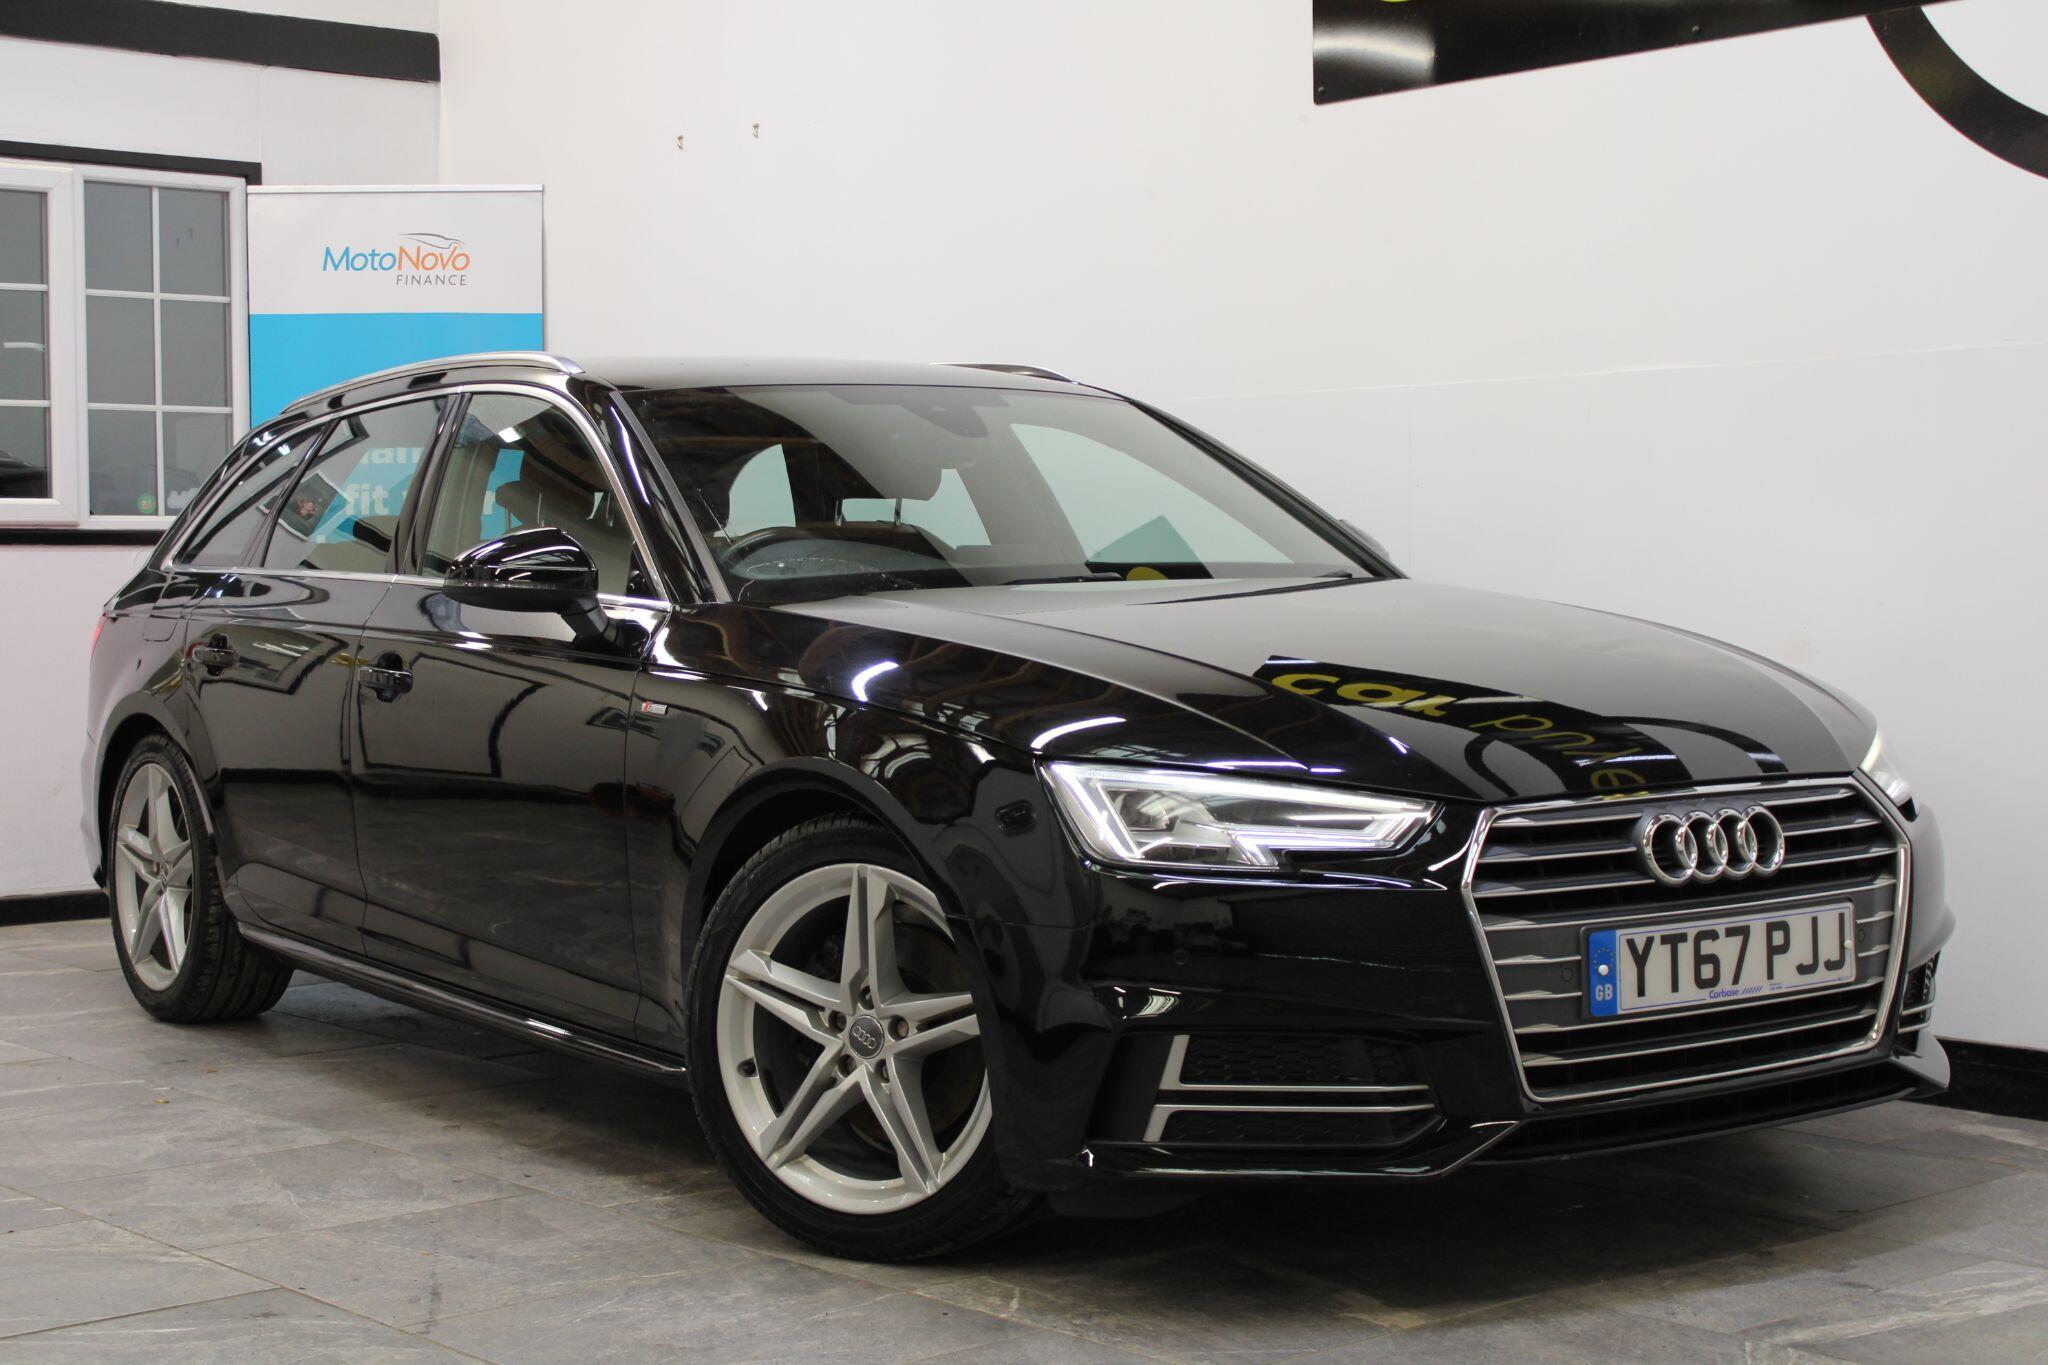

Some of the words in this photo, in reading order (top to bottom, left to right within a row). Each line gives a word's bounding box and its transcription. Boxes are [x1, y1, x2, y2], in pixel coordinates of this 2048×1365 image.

[322, 245, 471, 272] MotoNovo
[396, 274, 468, 286] FINANCE
[346, 483, 390, 515] fit
[1626, 925, 1751, 998] YT67
[1765, 912, 1846, 981] PJJ
[1594, 983, 1614, 1002] GB
